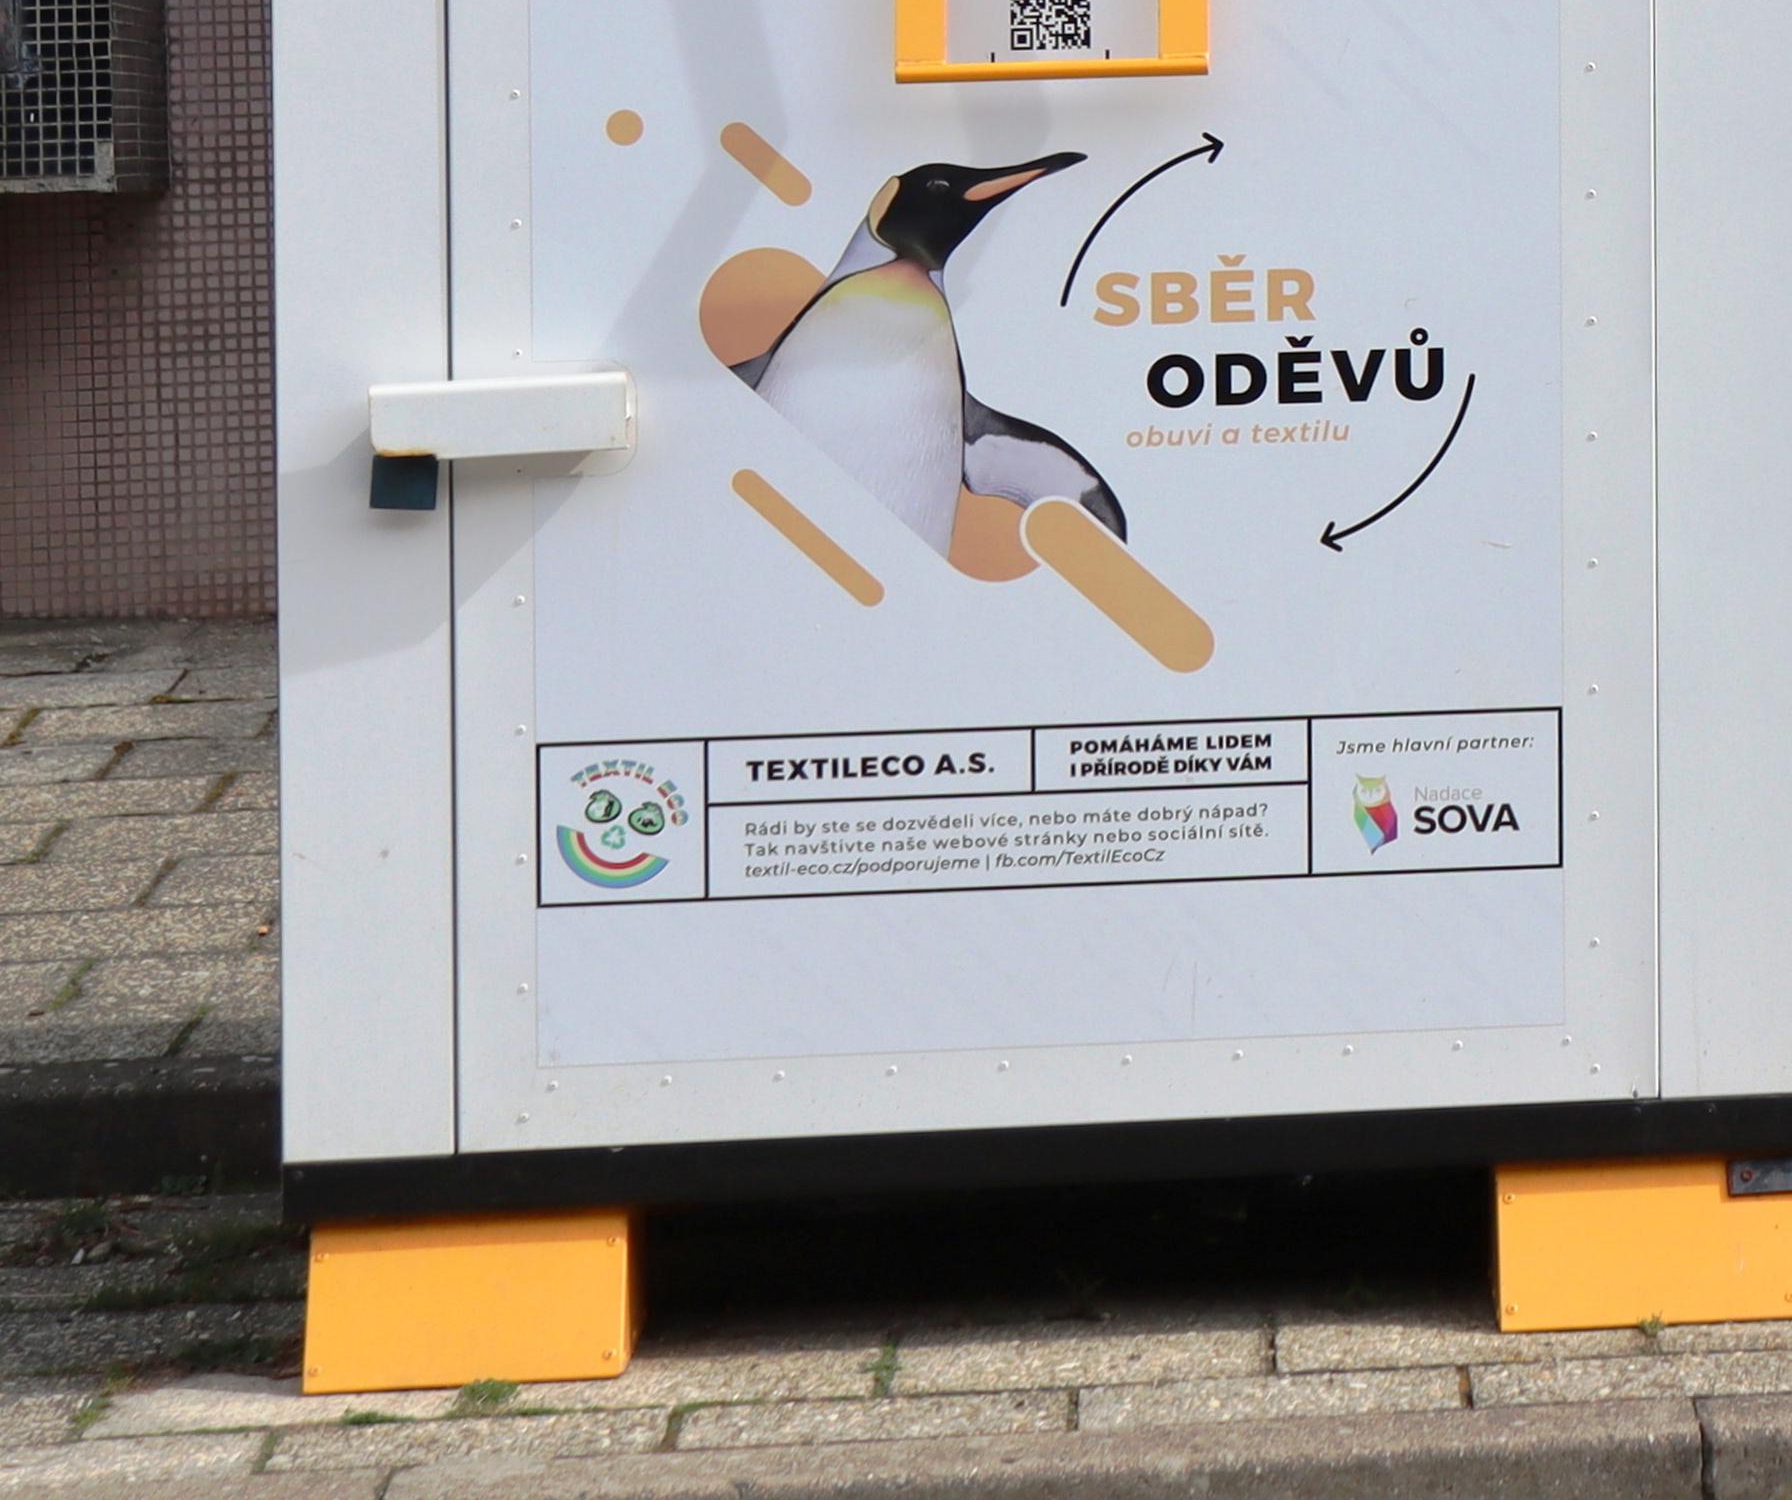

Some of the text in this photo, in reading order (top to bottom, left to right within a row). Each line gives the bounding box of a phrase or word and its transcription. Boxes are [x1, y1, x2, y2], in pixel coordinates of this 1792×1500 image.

[1092, 254, 1316, 327] SBĚR
[1146, 327, 1445, 409] ODĚVŮ
[1126, 419, 1350, 449] obuvi a textilu
[1070, 733, 1273, 755] POMÁHÁME LIDEM
[1335, 735, 1535, 755] Jsme hlavní partner:
[570, 759, 655, 788] TEXTIL
[746, 752, 996, 782] TEXTILECO A.S.
[1069, 752, 1273, 778] I PŘÍRODĚ DÍKY VÁM
[1414, 785, 1483, 801] Nadace
[744, 802, 1268, 838] Rádi by ste se dozvědeli více, nebo máte dobrý nápad?
[1413, 803, 1520, 835] SOVA
[744, 840, 779, 857] Tak
[881, 835, 928, 851] naše
[933, 831, 1008, 851] webové
[1013, 826, 1088, 847] stránky
[1093, 825, 1143, 843] nebo
[1147, 823, 1224, 842] sociální
[1229, 822, 1270, 838] sítě.
[744, 847, 1165, 879] textil-eco.cz/podporujeme fb.com/TextilEcoCz
